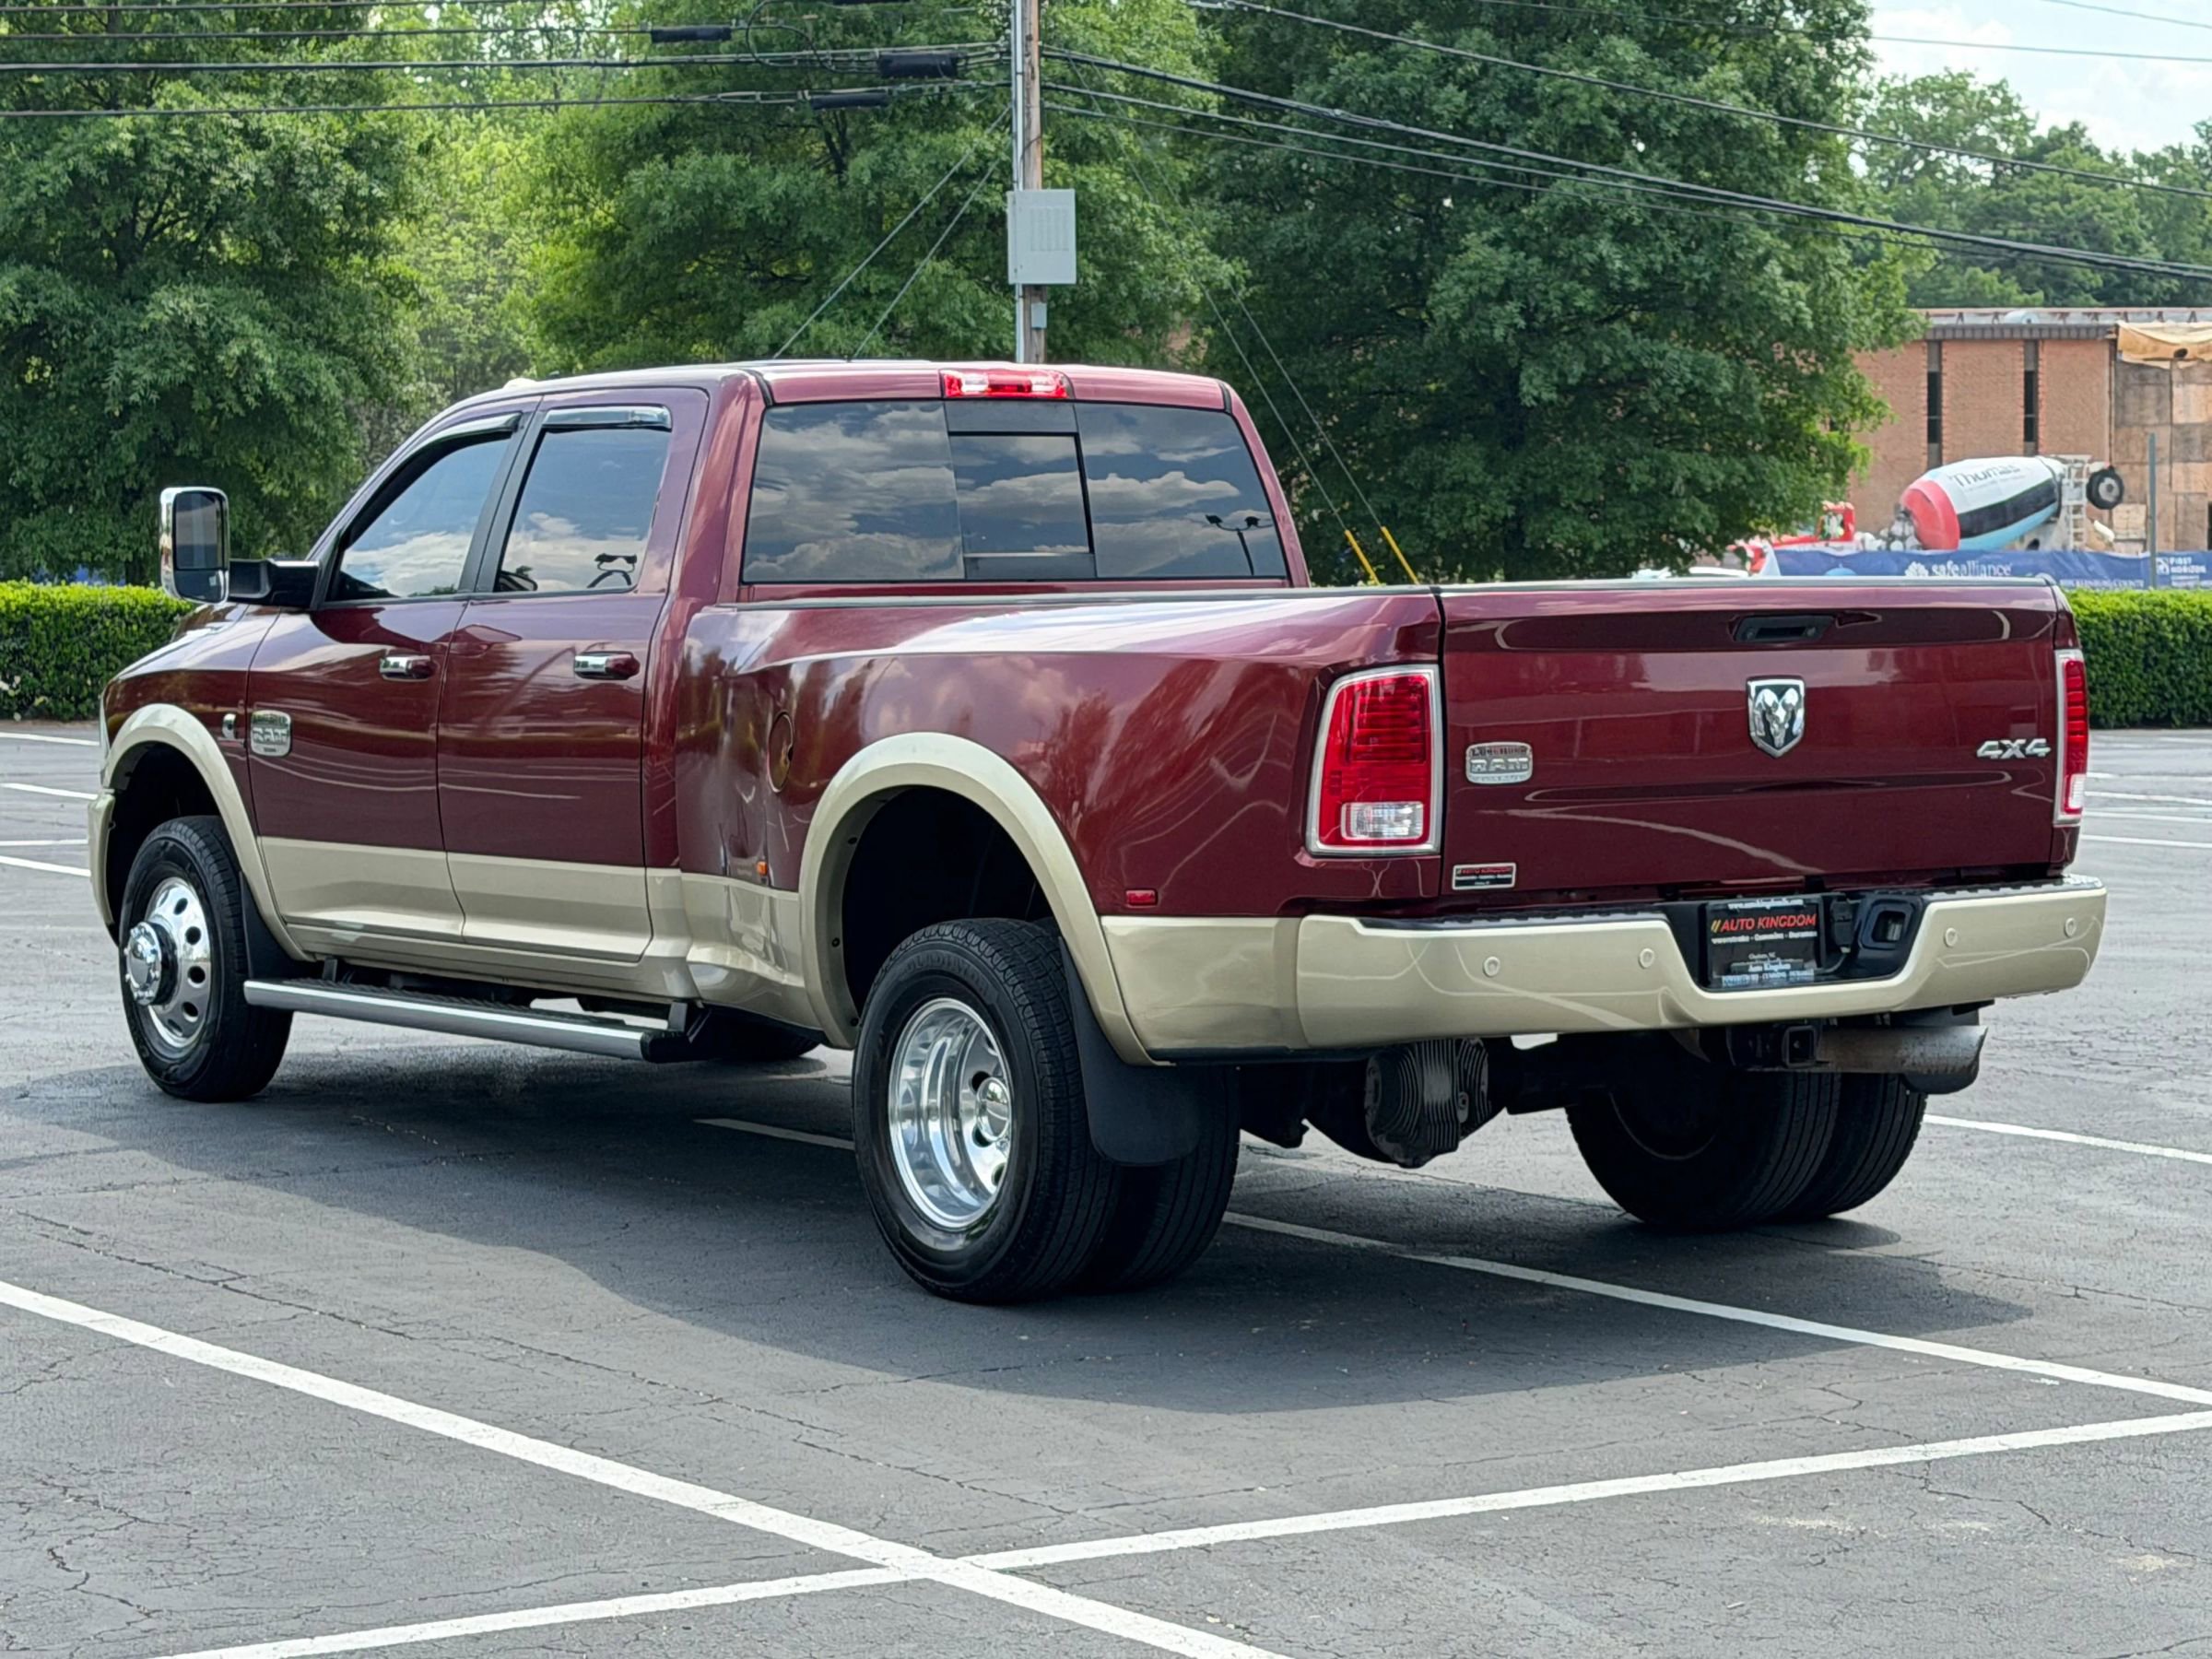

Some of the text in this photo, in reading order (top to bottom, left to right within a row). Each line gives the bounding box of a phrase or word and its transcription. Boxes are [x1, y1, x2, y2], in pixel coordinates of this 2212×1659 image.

[1470, 757, 1529, 772] RAM
[1720, 913, 1817, 933] AUTO KINGDOM
